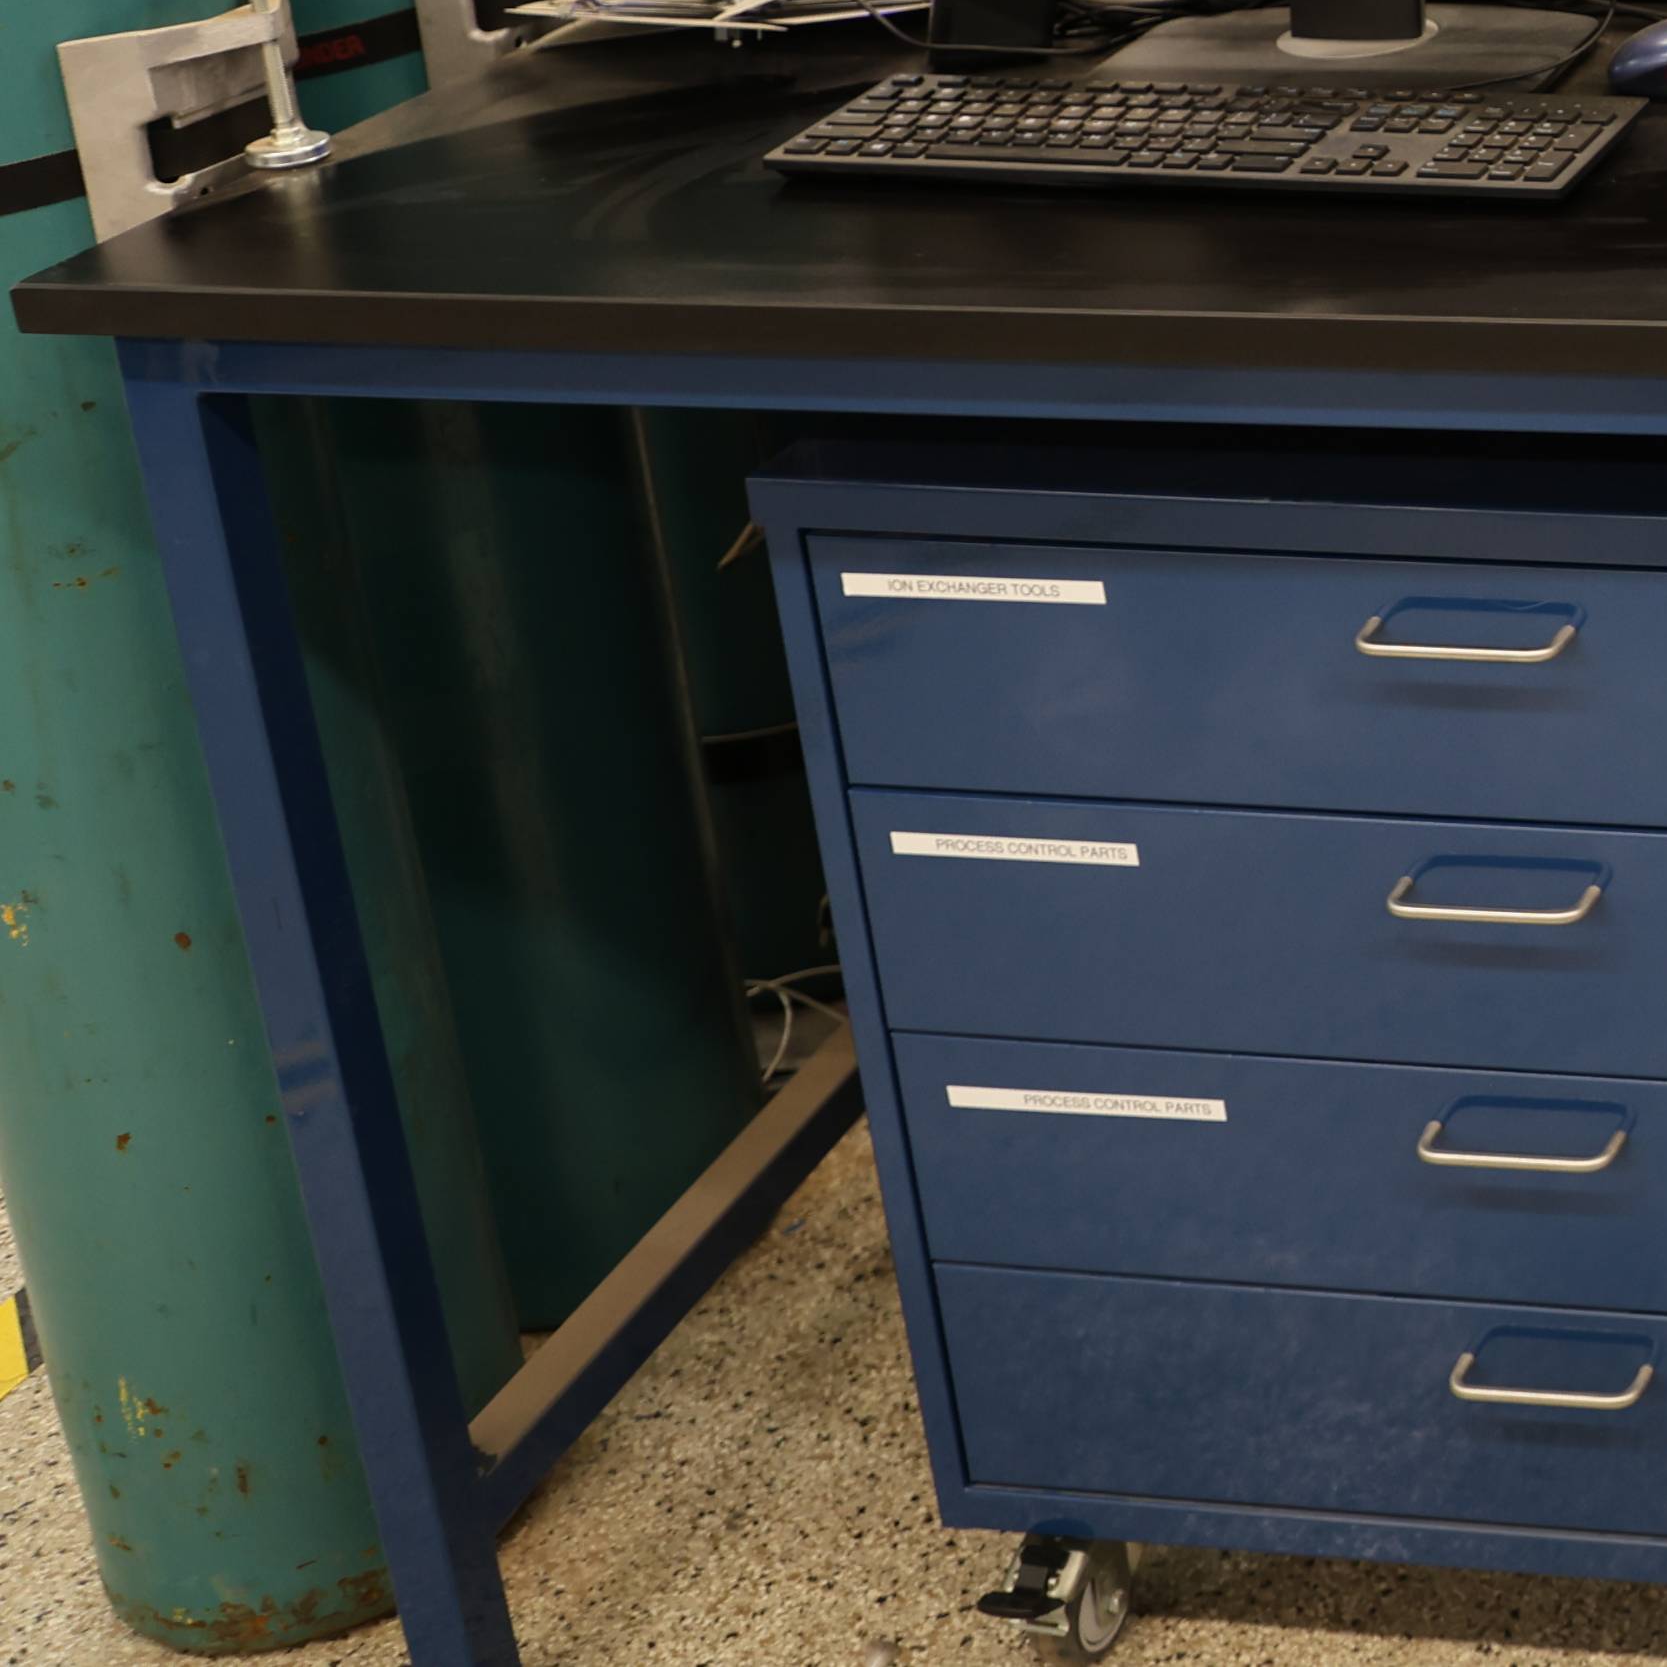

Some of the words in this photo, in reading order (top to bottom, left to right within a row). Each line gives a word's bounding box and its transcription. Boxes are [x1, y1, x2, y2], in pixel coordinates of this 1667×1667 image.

[887, 578, 914, 592] ION
[916, 579, 1008, 595] EXCHANGER
[1012, 583, 1061, 598] TOOLS
[935, 838, 1005, 854] PROCESS
[1007, 842, 1077, 858] CONTROL
[1080, 845, 1129, 861] PARTS
[1023, 1093, 1091, 1110] PROCESS
[1093, 1097, 1162, 1113] CONTROL
[1165, 1100, 1213, 1116] PARTS
